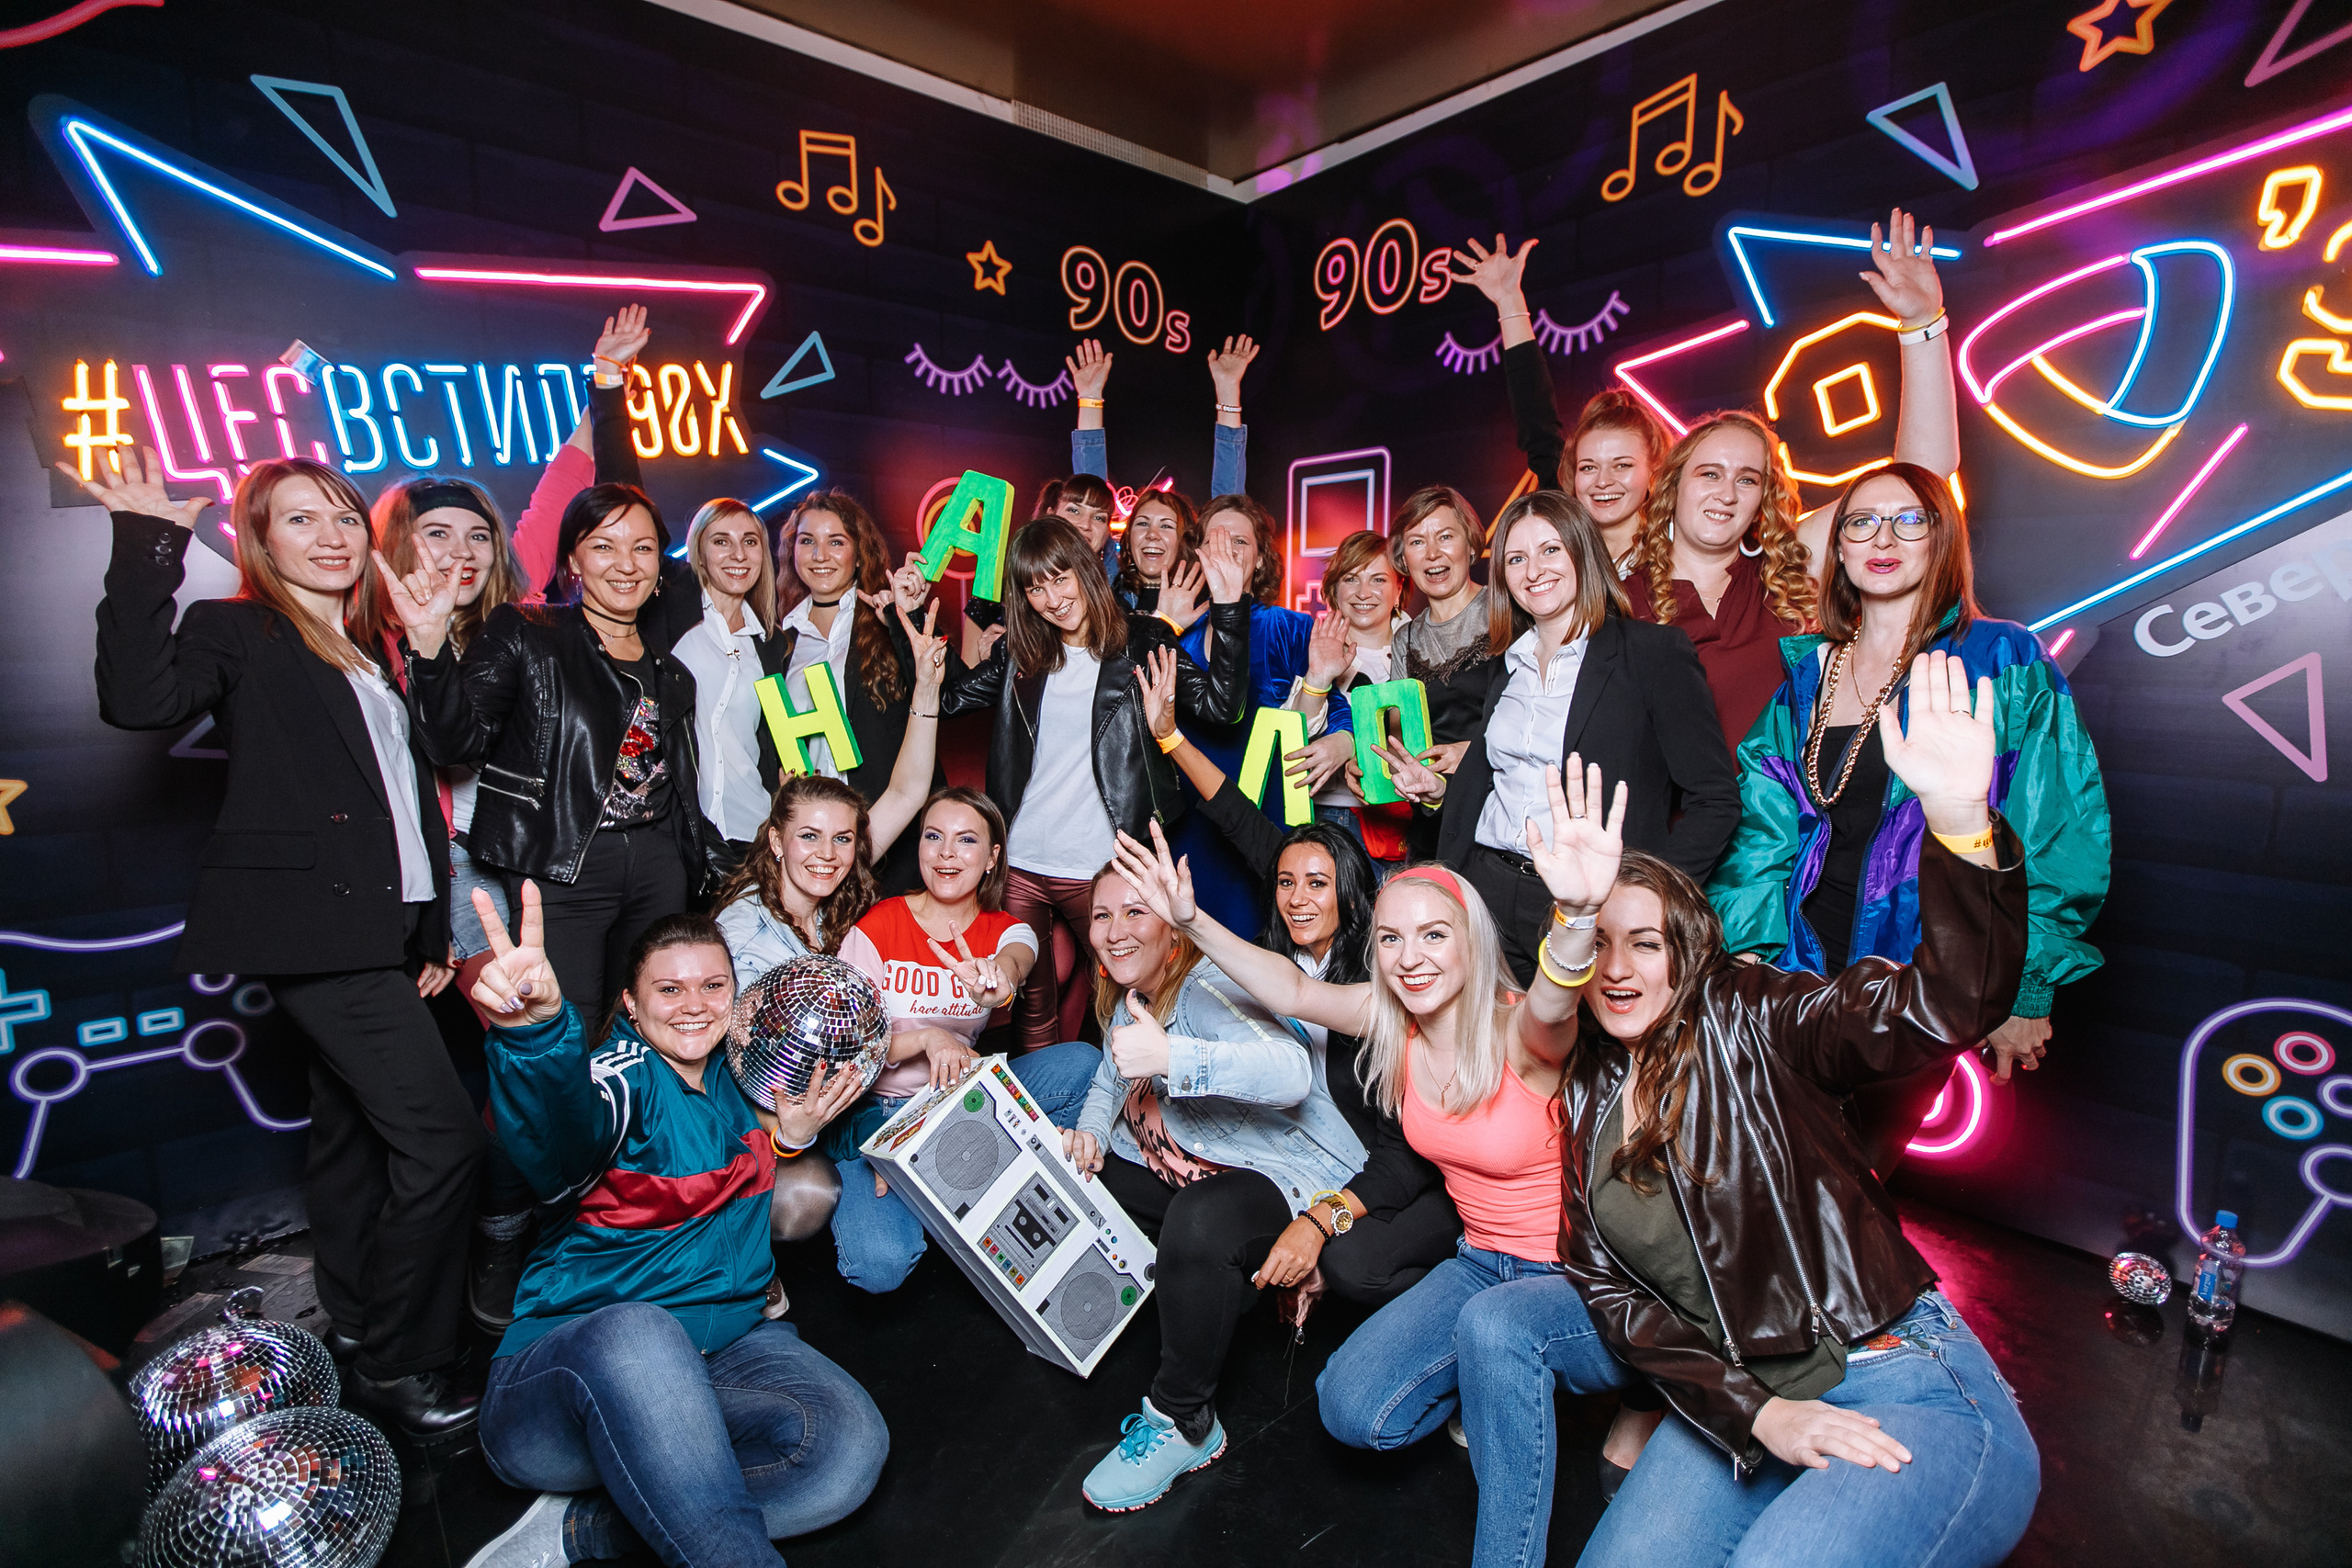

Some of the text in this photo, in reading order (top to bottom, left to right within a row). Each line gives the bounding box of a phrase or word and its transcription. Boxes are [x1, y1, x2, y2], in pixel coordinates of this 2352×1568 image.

[1061, 245, 1190, 353] 90s
[1314, 218, 1452, 331] 90s
[61, 358, 749, 503] #ЦЕСВСТИЛ90Х
[882, 964, 939, 997] GOOD
[910, 999, 939, 1014] have
